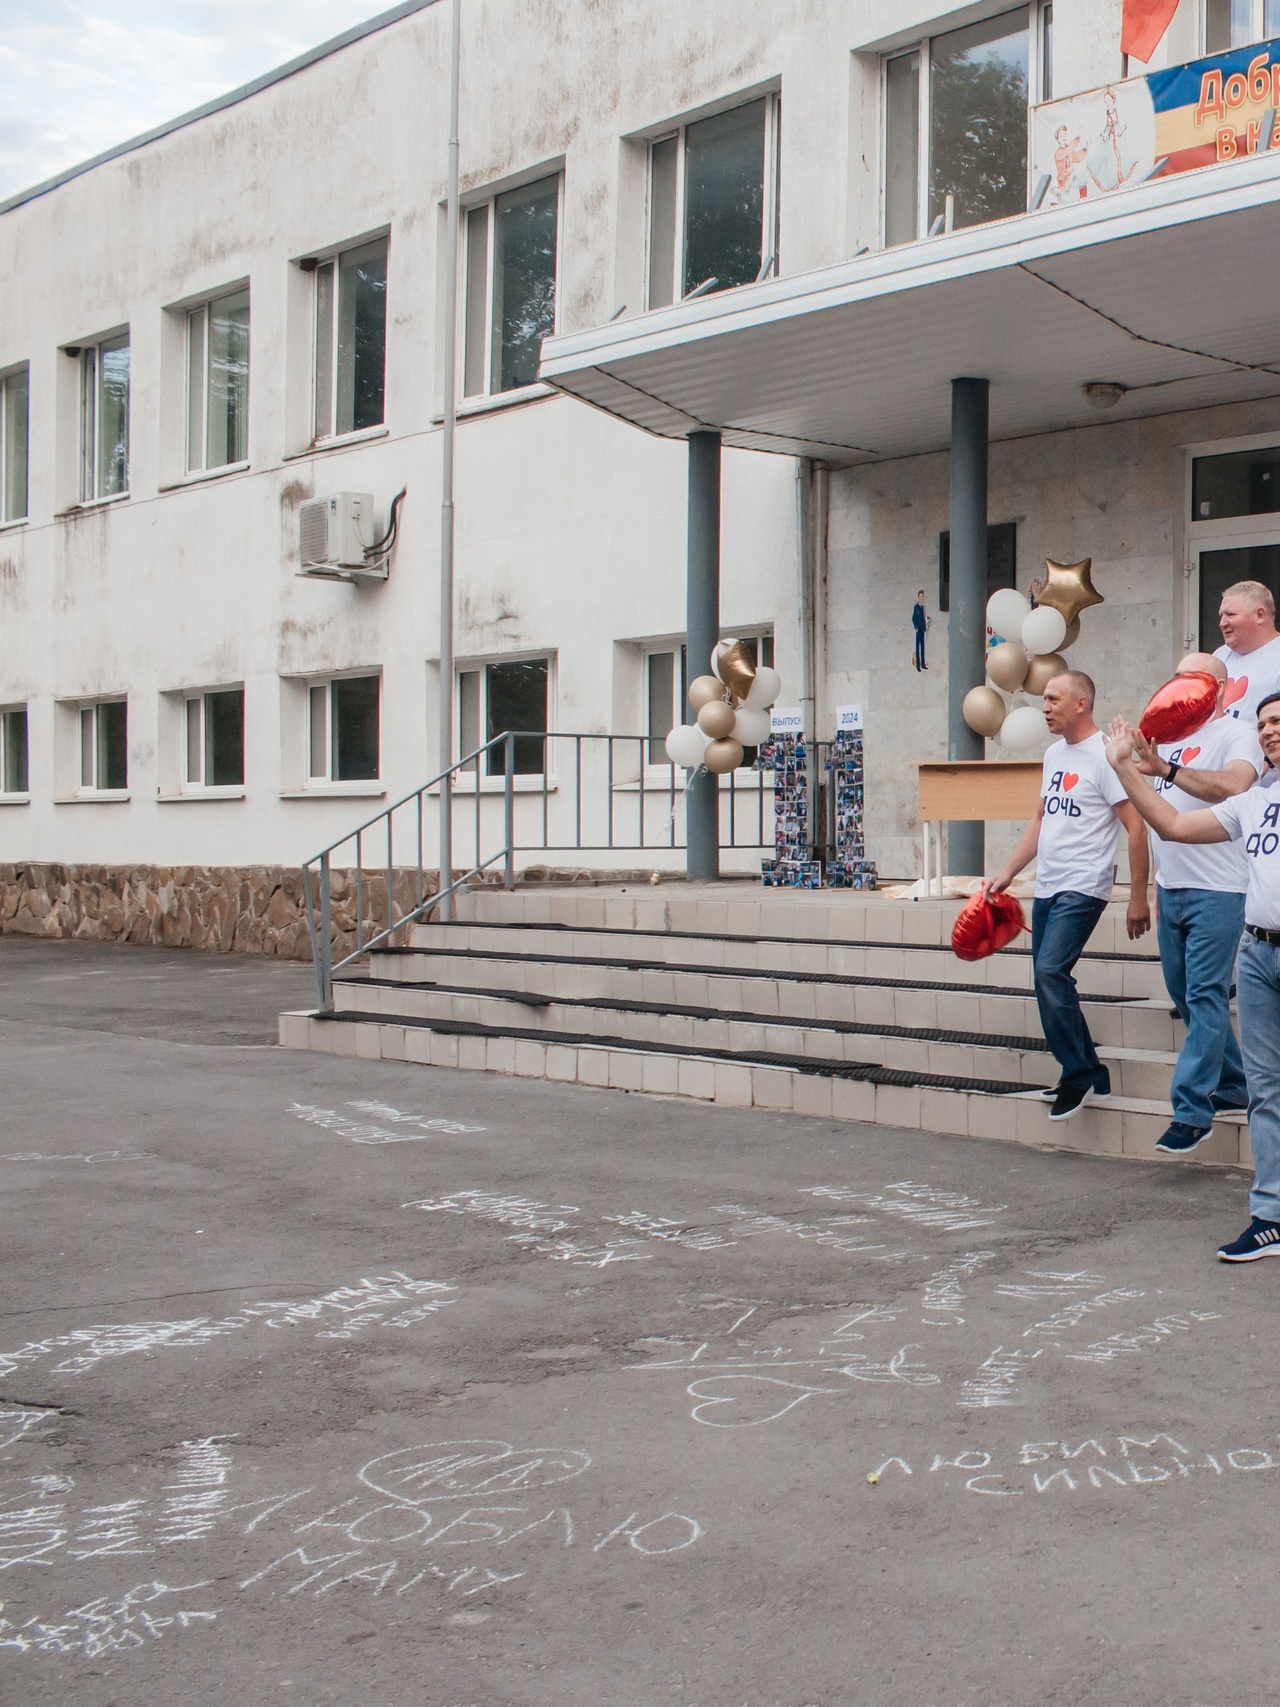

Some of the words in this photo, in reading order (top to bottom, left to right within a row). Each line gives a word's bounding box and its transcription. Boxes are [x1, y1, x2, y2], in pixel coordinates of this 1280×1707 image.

[1216, 126, 1237, 161] в
[841, 712, 859, 724] 2024
[1048, 771, 1064, 793] Я
[1043, 796, 1082, 818] ОЧЬ
[1260, 802, 1280, 828] Я
